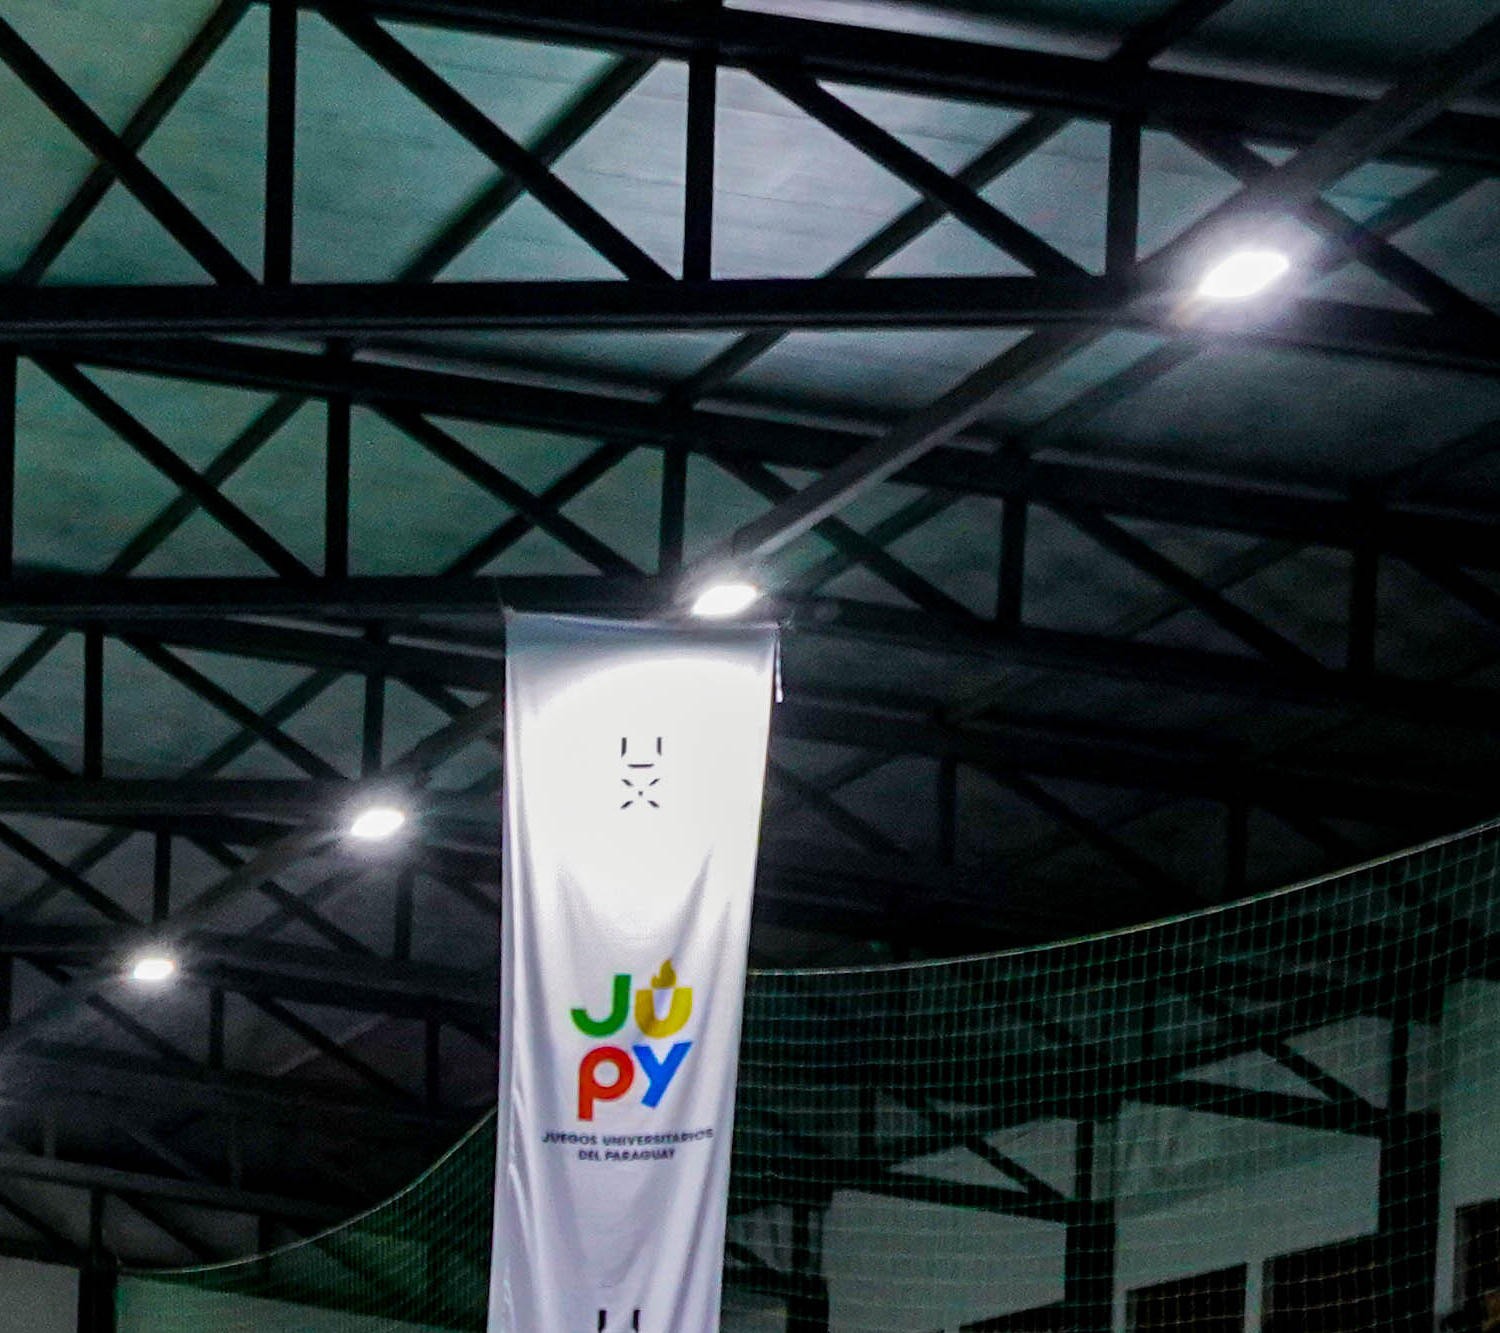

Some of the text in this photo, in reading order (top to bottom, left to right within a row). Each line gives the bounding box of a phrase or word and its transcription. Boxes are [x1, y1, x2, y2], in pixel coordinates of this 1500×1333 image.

[542, 1130, 598, 1146] JUEGOS
[578, 1147, 675, 1161] DEL PARAGUAY
